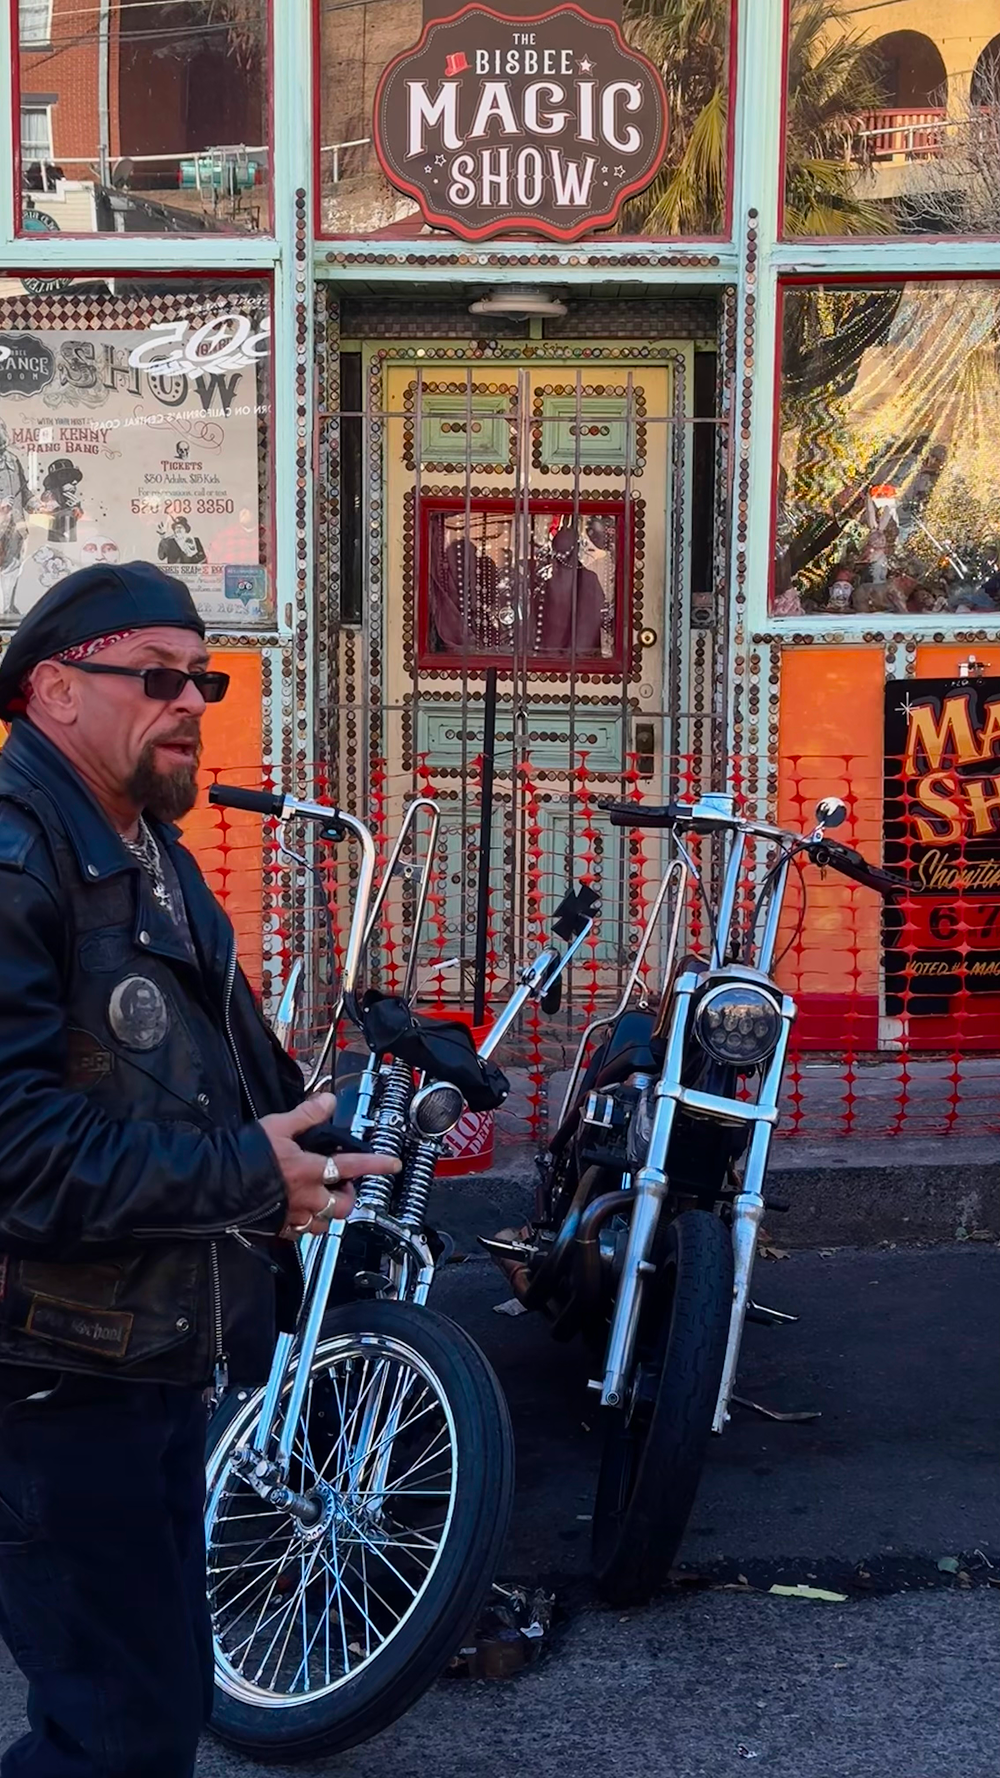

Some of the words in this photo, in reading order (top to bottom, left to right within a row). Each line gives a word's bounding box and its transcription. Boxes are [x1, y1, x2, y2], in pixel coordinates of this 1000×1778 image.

[513, 33, 536, 45] THE
[475, 50, 574, 75] BISBEE
[405, 80, 643, 159] MAGIC
[449, 147, 596, 206] SHOW
[60, 427, 112, 443] KENNY
[65, 442, 100, 455] BANG
[164, 499, 192, 514] 203
[197, 498, 235, 514] 3350
[929, 904, 959, 941] 6
[905, 961, 949, 976] VOTED
[442, 1110, 488, 1158] HO
